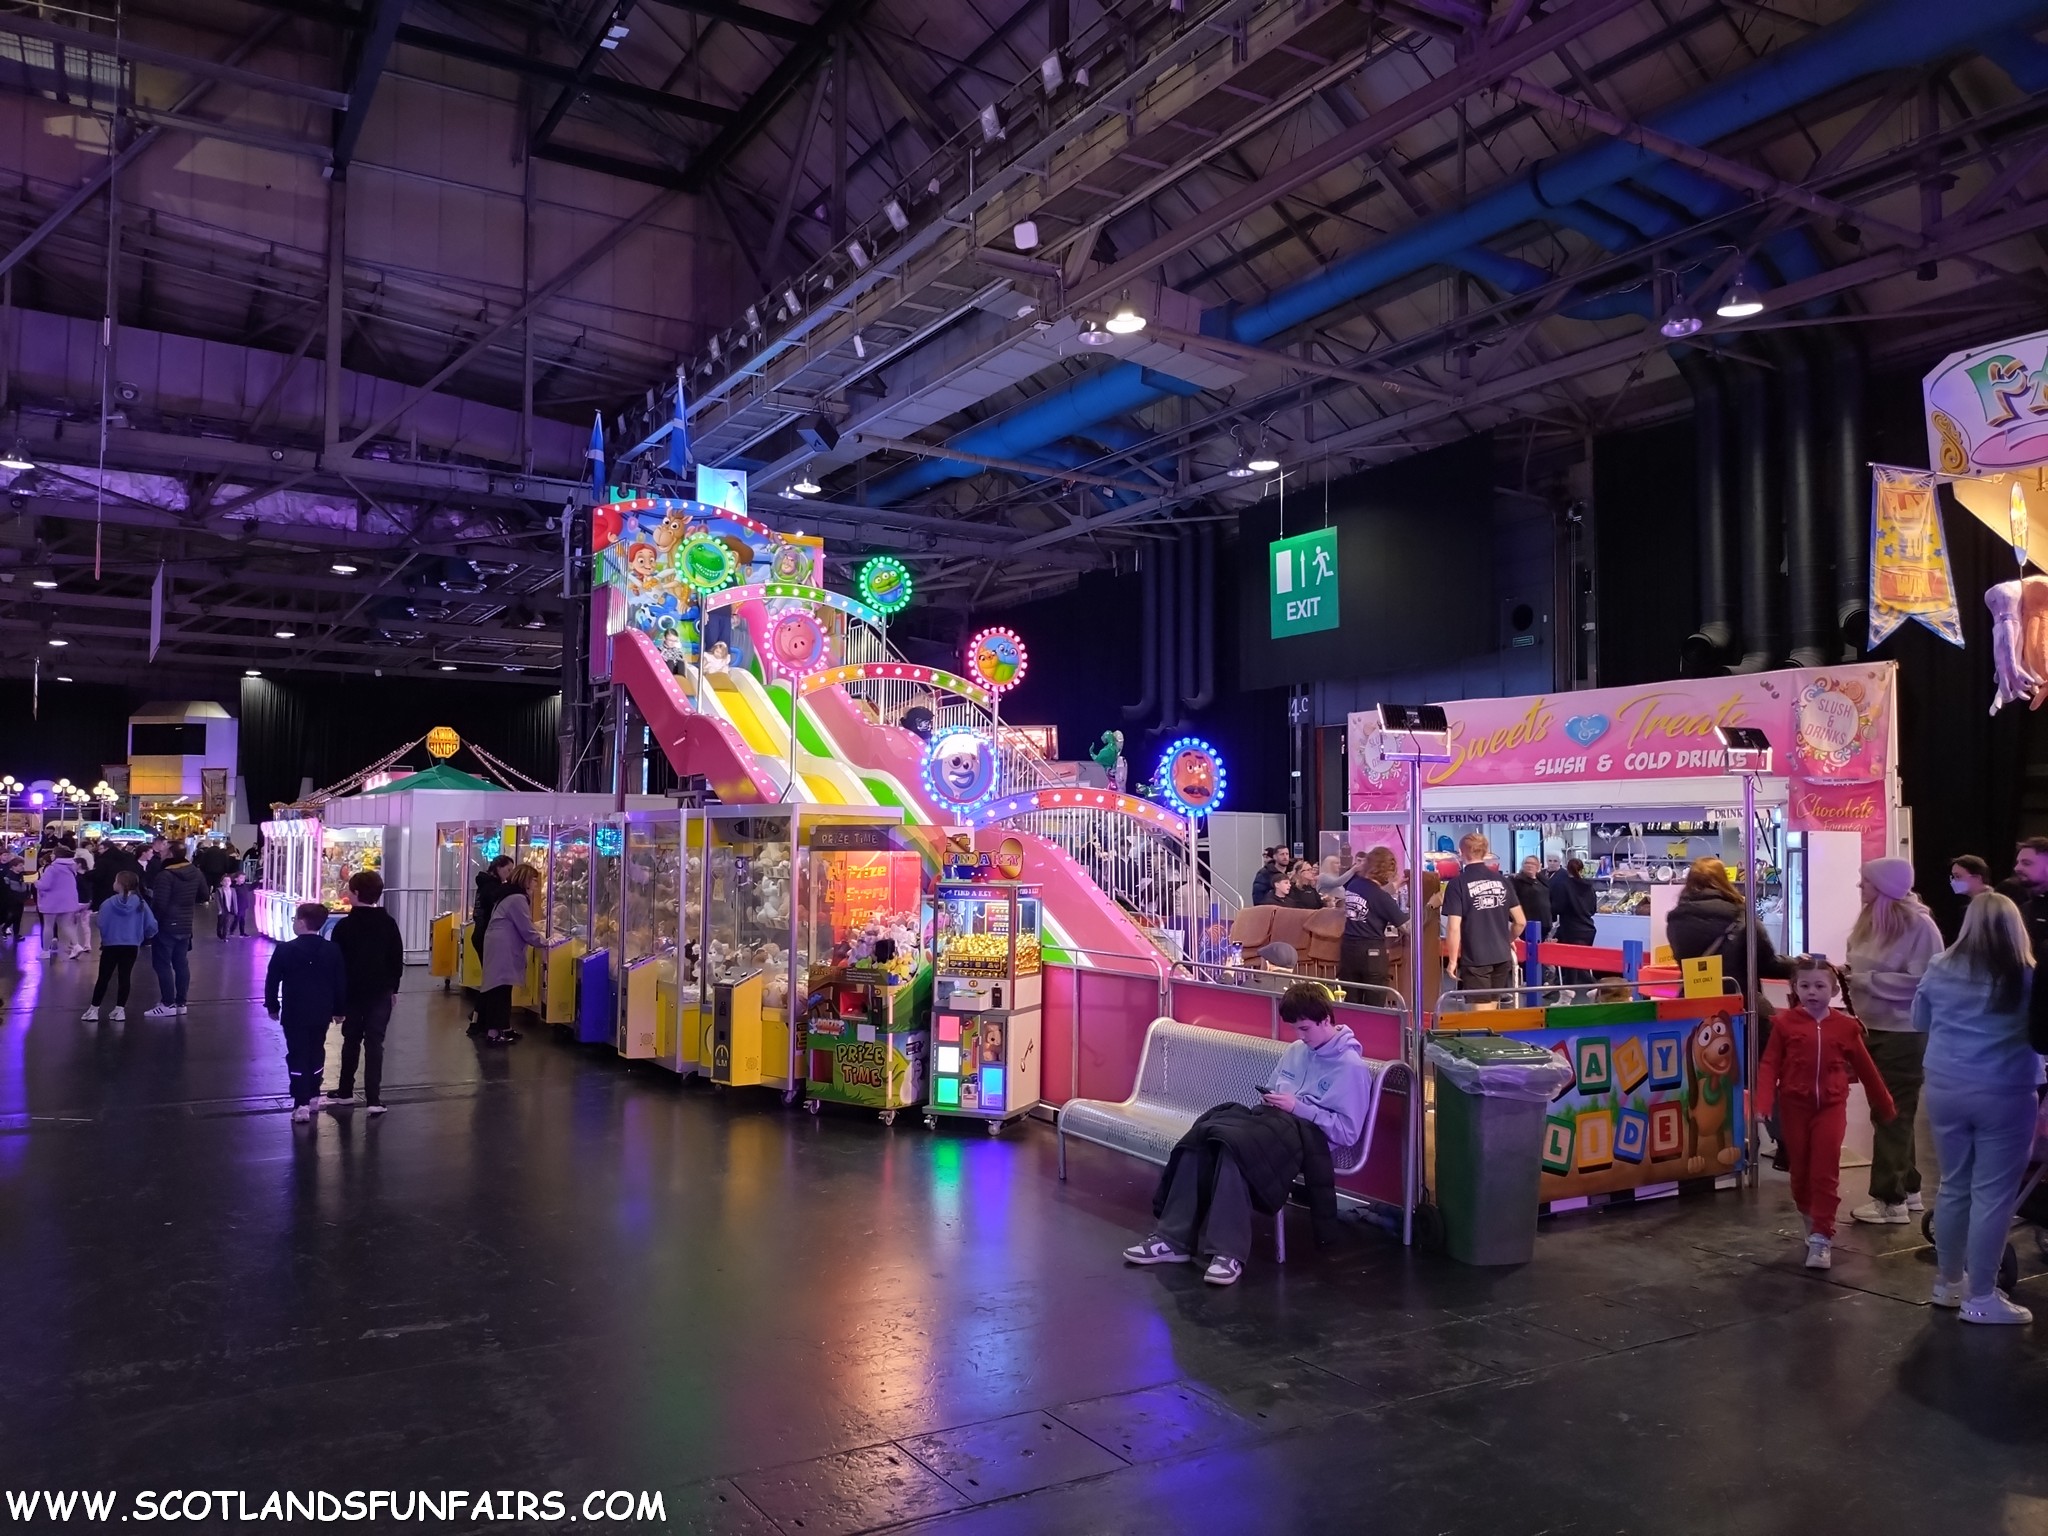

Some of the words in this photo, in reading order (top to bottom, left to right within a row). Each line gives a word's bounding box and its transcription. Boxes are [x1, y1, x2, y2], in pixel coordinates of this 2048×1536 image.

[1286, 596, 1321, 621] EXIT
[1817, 698, 1852, 719] SLUSH
[1826, 715, 1835, 728] &
[1427, 699, 1557, 785] Sweets
[1616, 691, 1749, 750] Treats
[1804, 723, 1847, 746] DRINKS
[428, 742, 458, 756] BINGO
[1534, 754, 1588, 777] SLUSH
[1596, 753, 1614, 773] &
[1624, 751, 1672, 772] COLD
[1714, 808, 1744, 819] DRINK
[1796, 792, 1876, 819] Chocolate
[1427, 814, 1483, 824] CATERING
[1487, 814, 1509, 823] FOR
[1513, 813, 1548, 823] GOOD
[1551, 812, 1594, 822] TASTE!
[978, 853, 991, 866] A
[953, 889, 970, 897] FIND
[1585, 1045, 1673, 1078] AZY
[1549, 1115, 1672, 1157] LIDE
